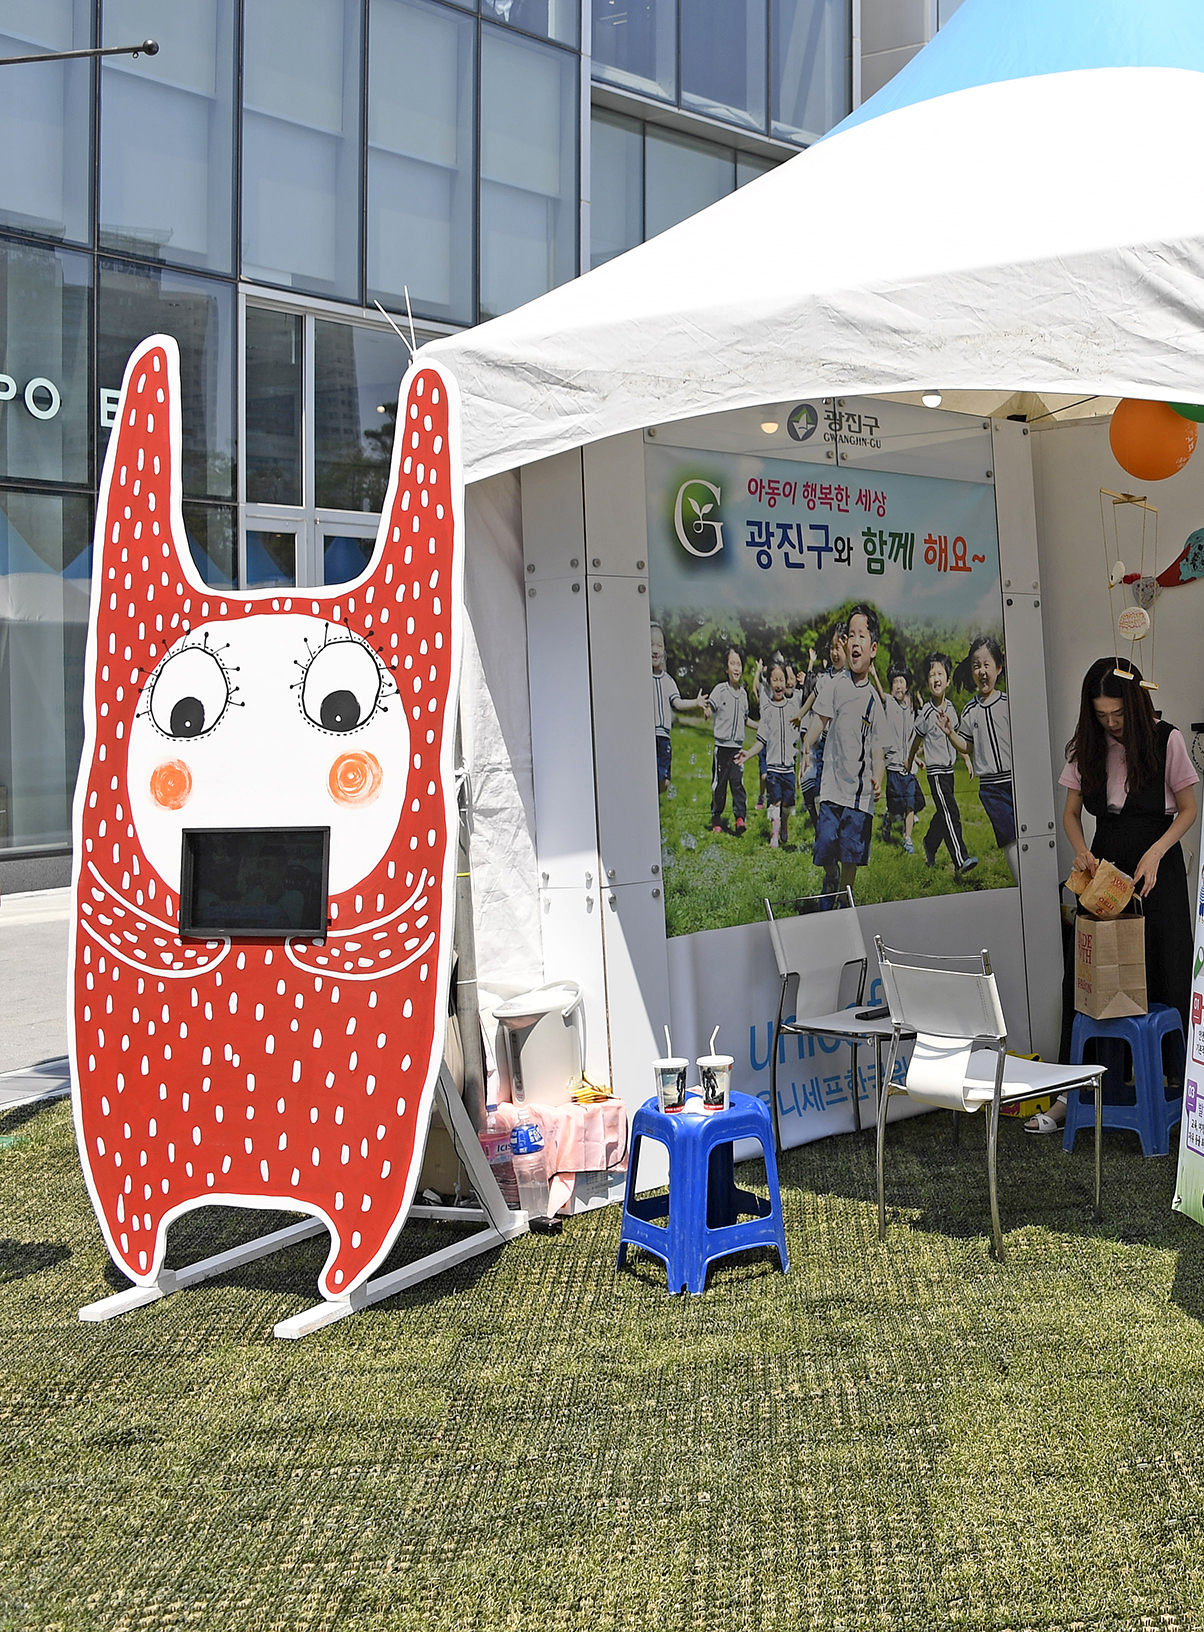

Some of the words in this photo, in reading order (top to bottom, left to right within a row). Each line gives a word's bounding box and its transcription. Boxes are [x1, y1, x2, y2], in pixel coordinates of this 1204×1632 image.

[823, 409, 880, 436] 광진구
[823, 432, 882, 449] GWANGJIN-GU
[747, 477, 797, 508] 아동이
[802, 481, 850, 513] 행복한
[855, 487, 887, 517] 세상
[745, 519, 853, 571] 광진구와
[861, 526, 915, 575] 함께
[923, 533, 986, 573] 해요~
